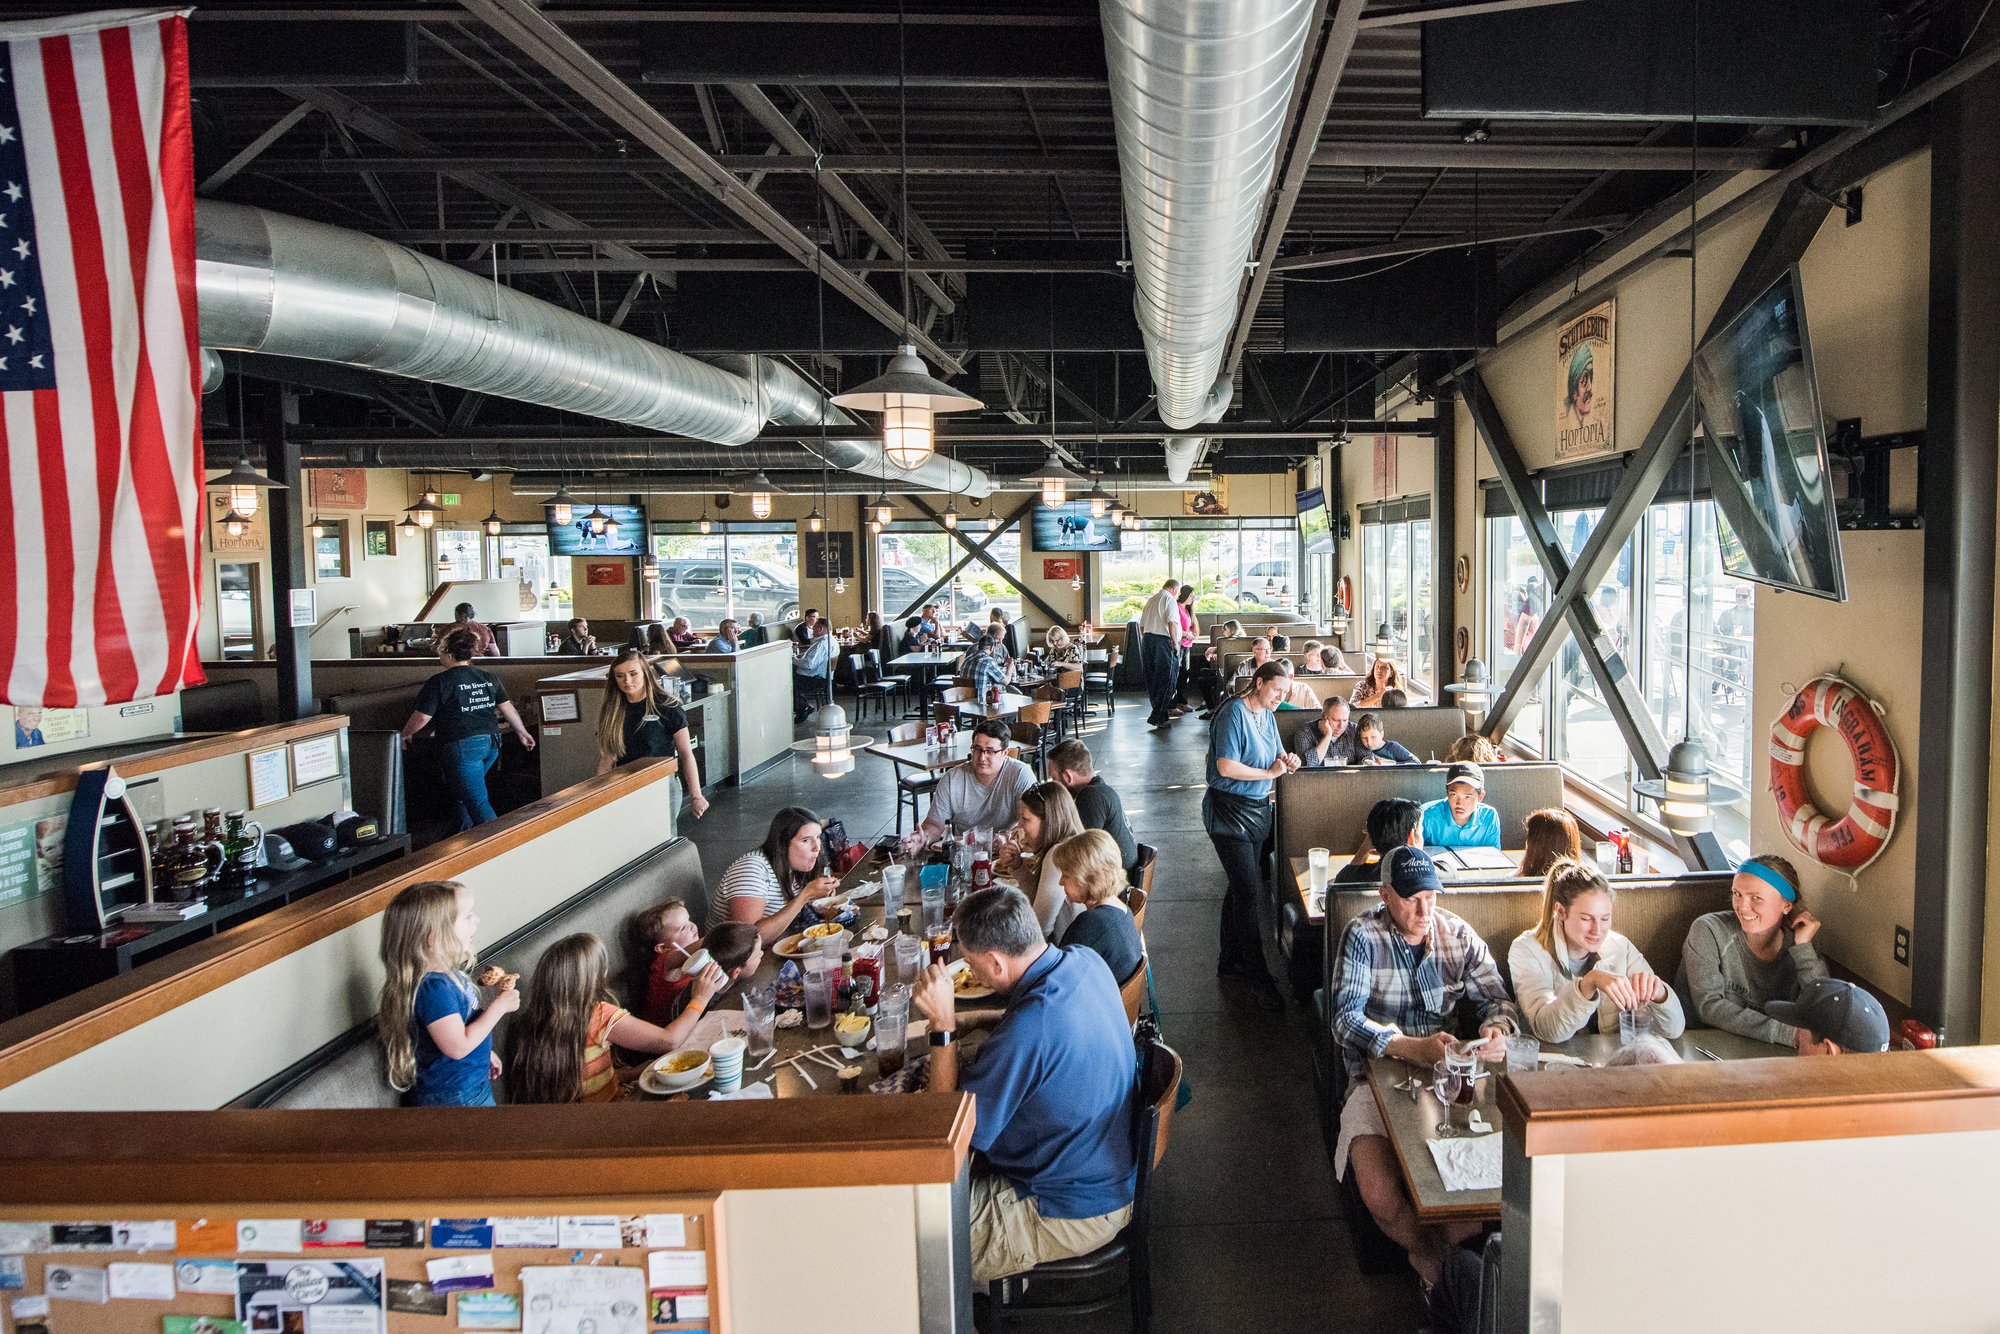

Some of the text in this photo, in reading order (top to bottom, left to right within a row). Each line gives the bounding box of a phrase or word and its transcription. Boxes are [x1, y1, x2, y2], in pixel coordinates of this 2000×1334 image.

[1559, 315, 1609, 358] SCUTTLEBUTT
[1560, 420, 1605, 451] HOPTOPIA
[219, 538, 261, 548] HOPTOPIA
[1832, 695, 1876, 782] INGRAHAM
[1401, 857, 1430, 869] Alaska
[296, 1268, 311, 1276] The
